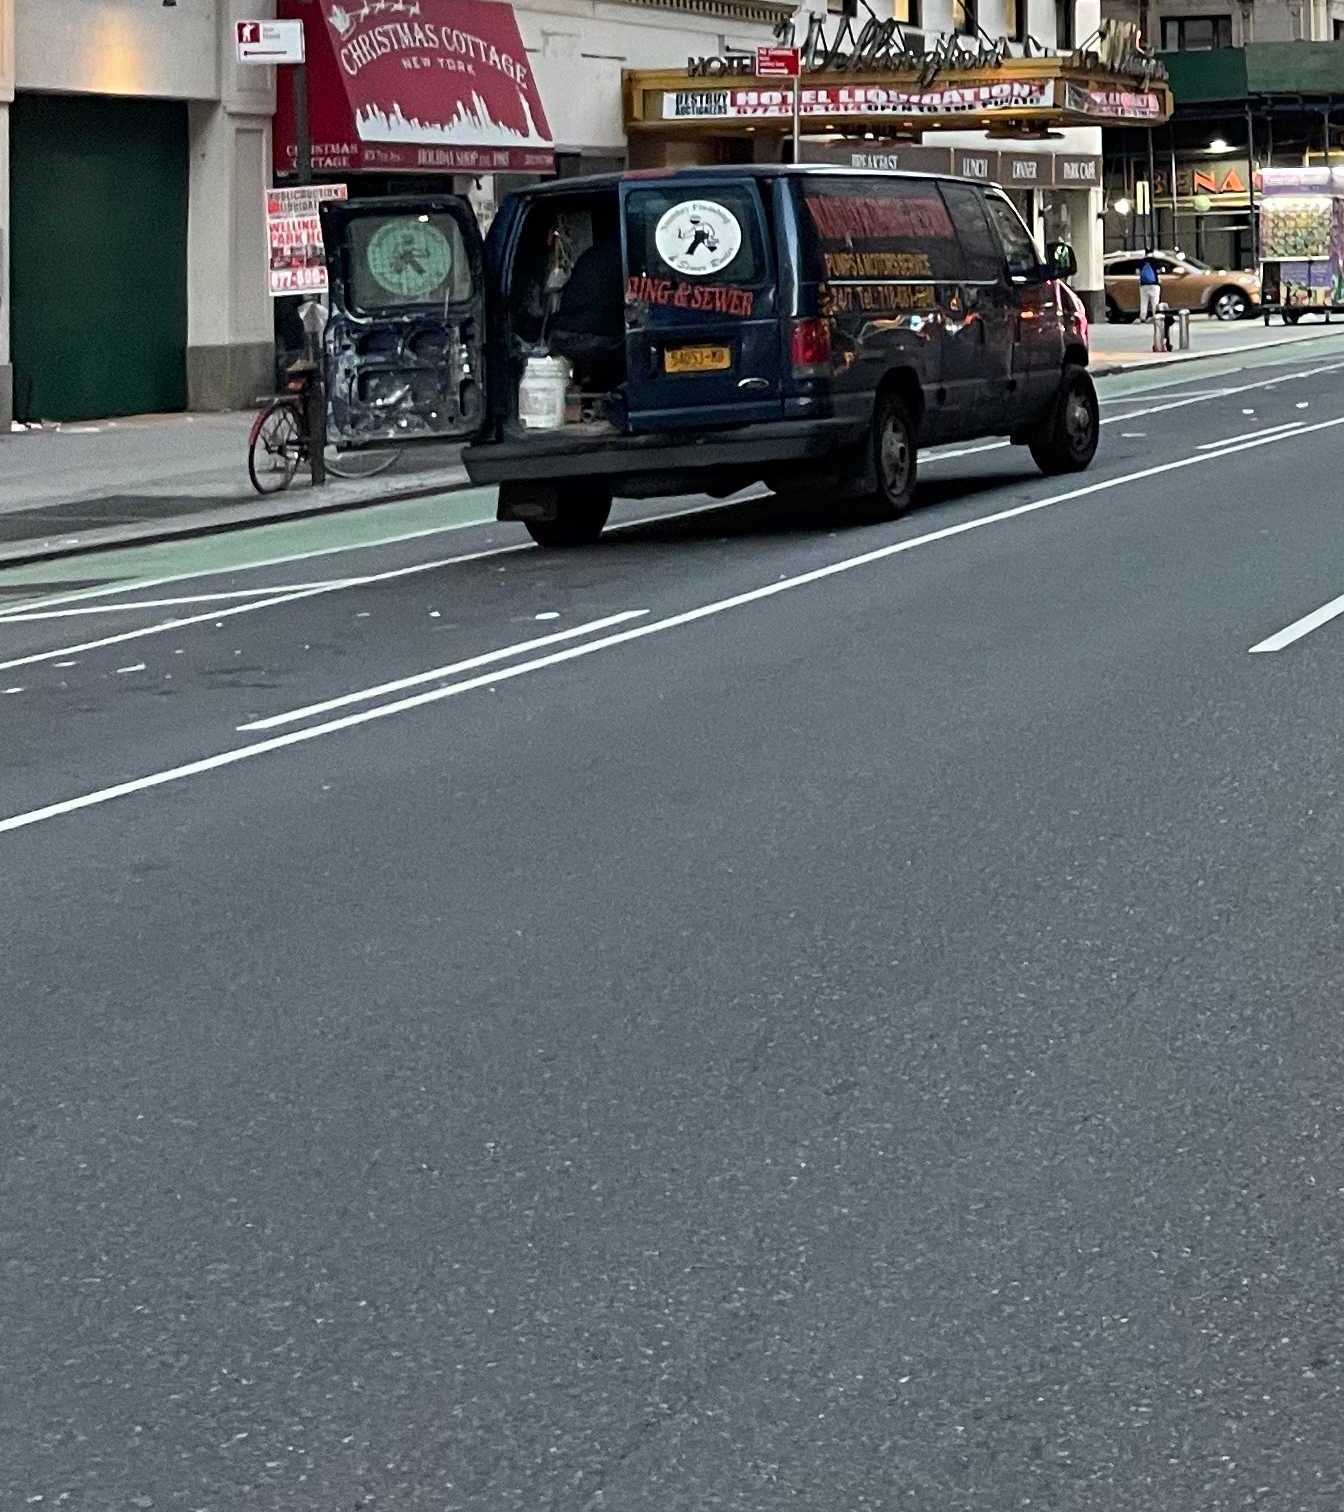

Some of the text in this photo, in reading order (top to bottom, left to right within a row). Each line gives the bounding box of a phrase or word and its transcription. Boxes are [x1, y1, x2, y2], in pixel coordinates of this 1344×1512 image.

[340, 21, 528, 89] CHRISTMAS COTTAGE
[403, 56, 476, 76] NEW YORK
[736, 90, 832, 106] HOTEL
[962, 158, 989, 179] LUNCH
[692, 285, 753, 317] SEWER
